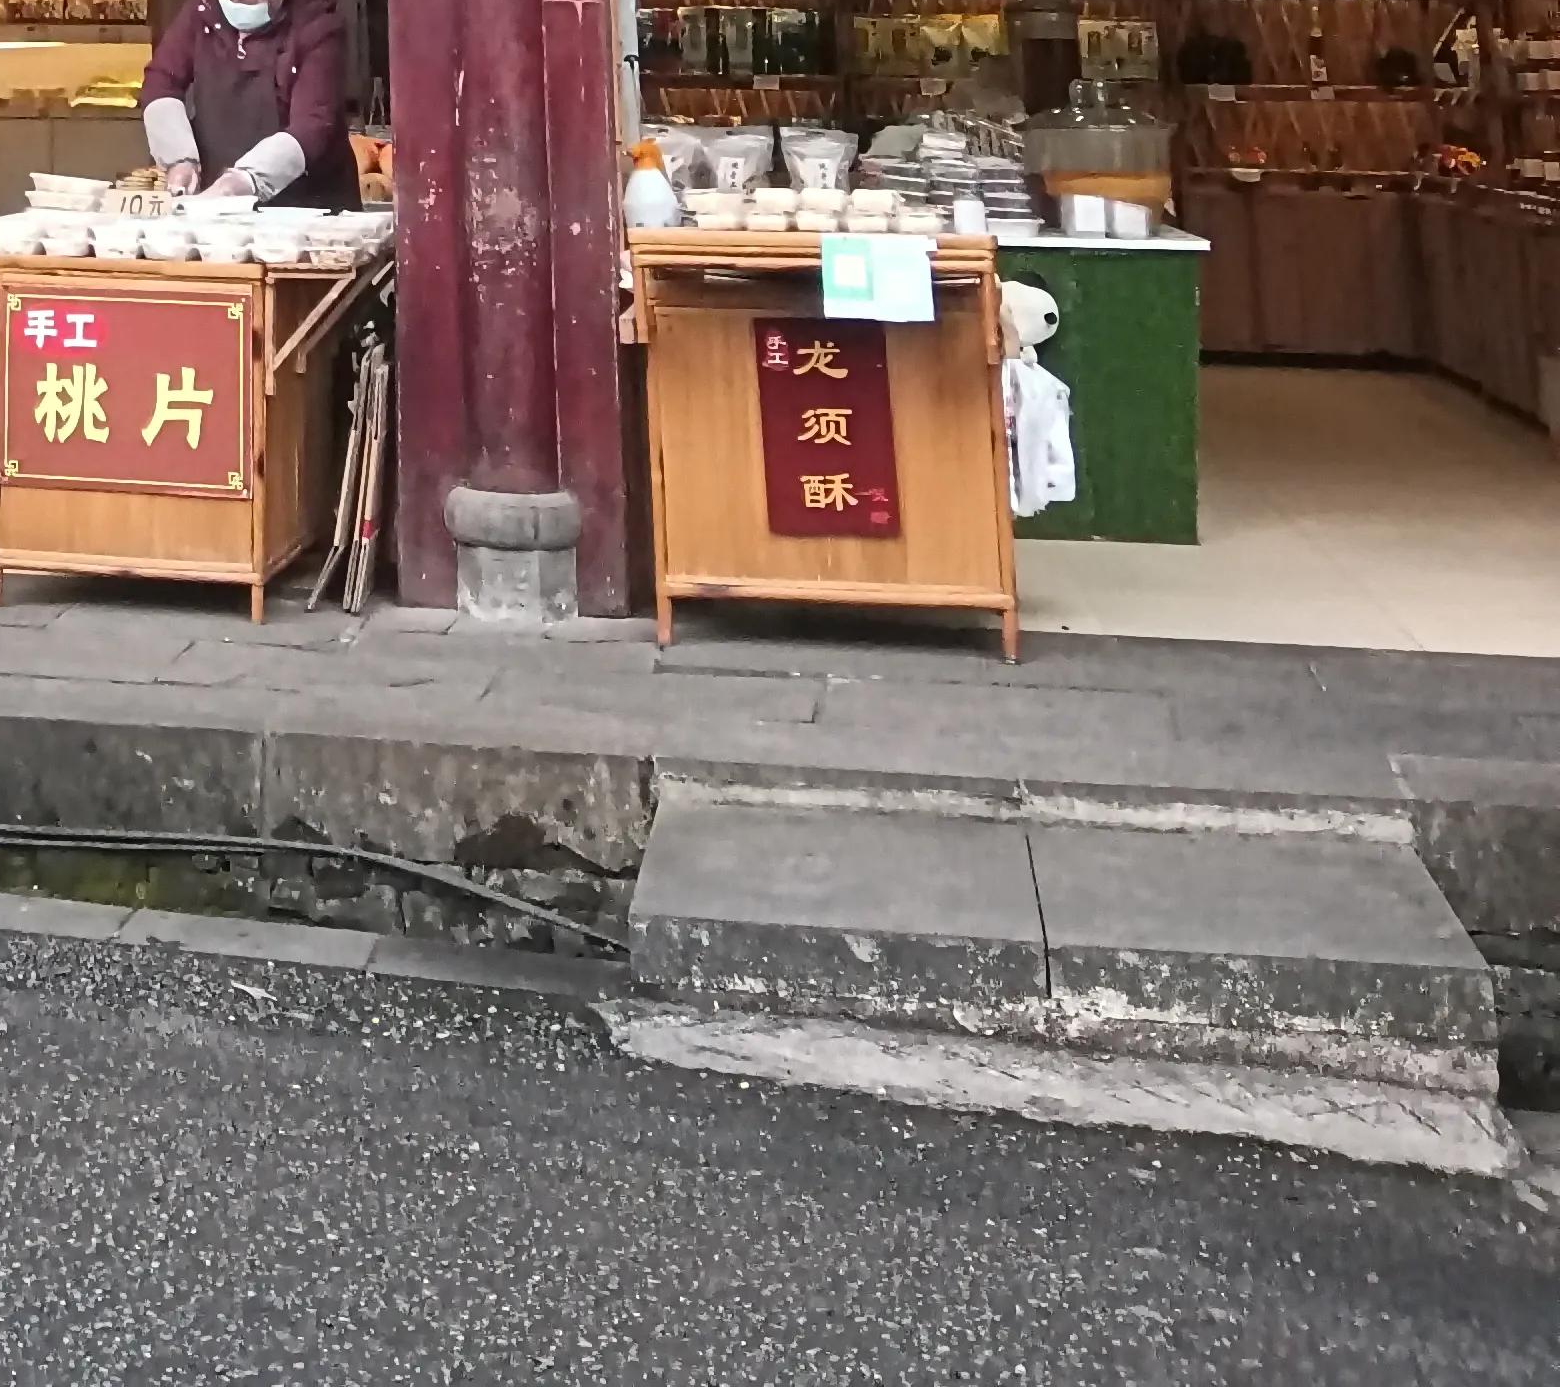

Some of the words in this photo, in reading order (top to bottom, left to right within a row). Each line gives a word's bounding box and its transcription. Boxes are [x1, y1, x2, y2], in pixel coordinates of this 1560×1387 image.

[120, 194, 164, 216] 10元
[23, 309, 98, 349] 手工
[34, 362, 215, 450] 桃片
[792, 339, 860, 512] 龙须酥
